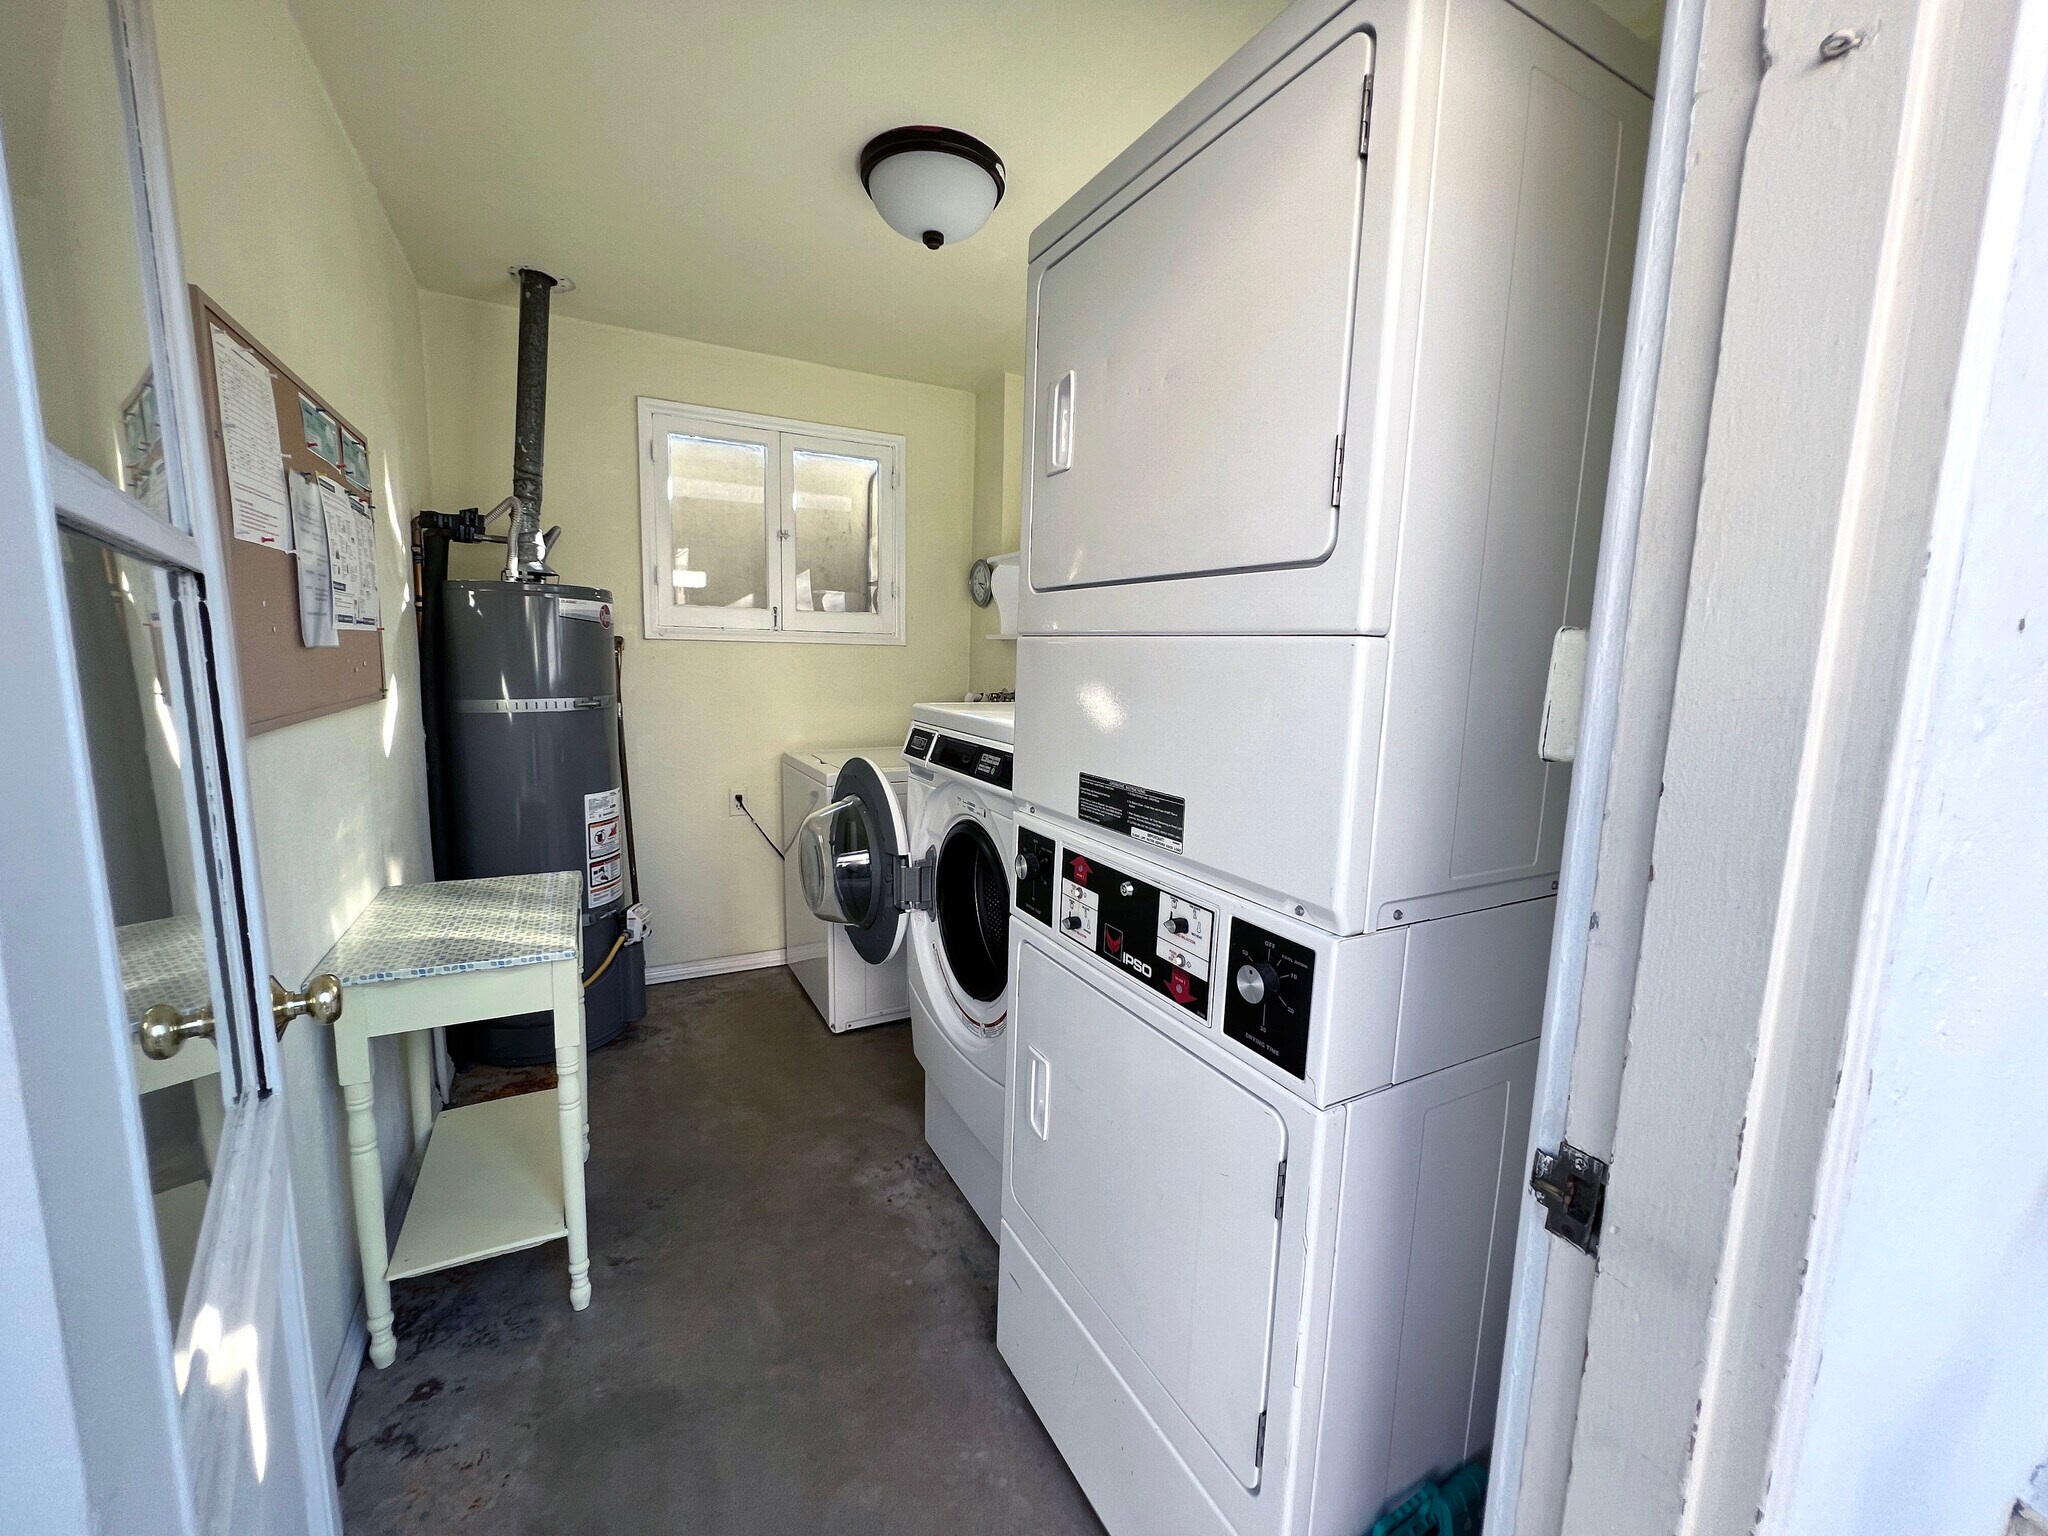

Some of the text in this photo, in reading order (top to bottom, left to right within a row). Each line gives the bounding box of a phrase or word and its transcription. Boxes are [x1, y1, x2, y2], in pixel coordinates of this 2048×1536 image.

[1264, 940, 1276, 949] OFF
[1122, 951, 1152, 978] IPSO
[1290, 972, 1298, 980] 10
[1245, 1032, 1280, 1057] DRYING TIME
